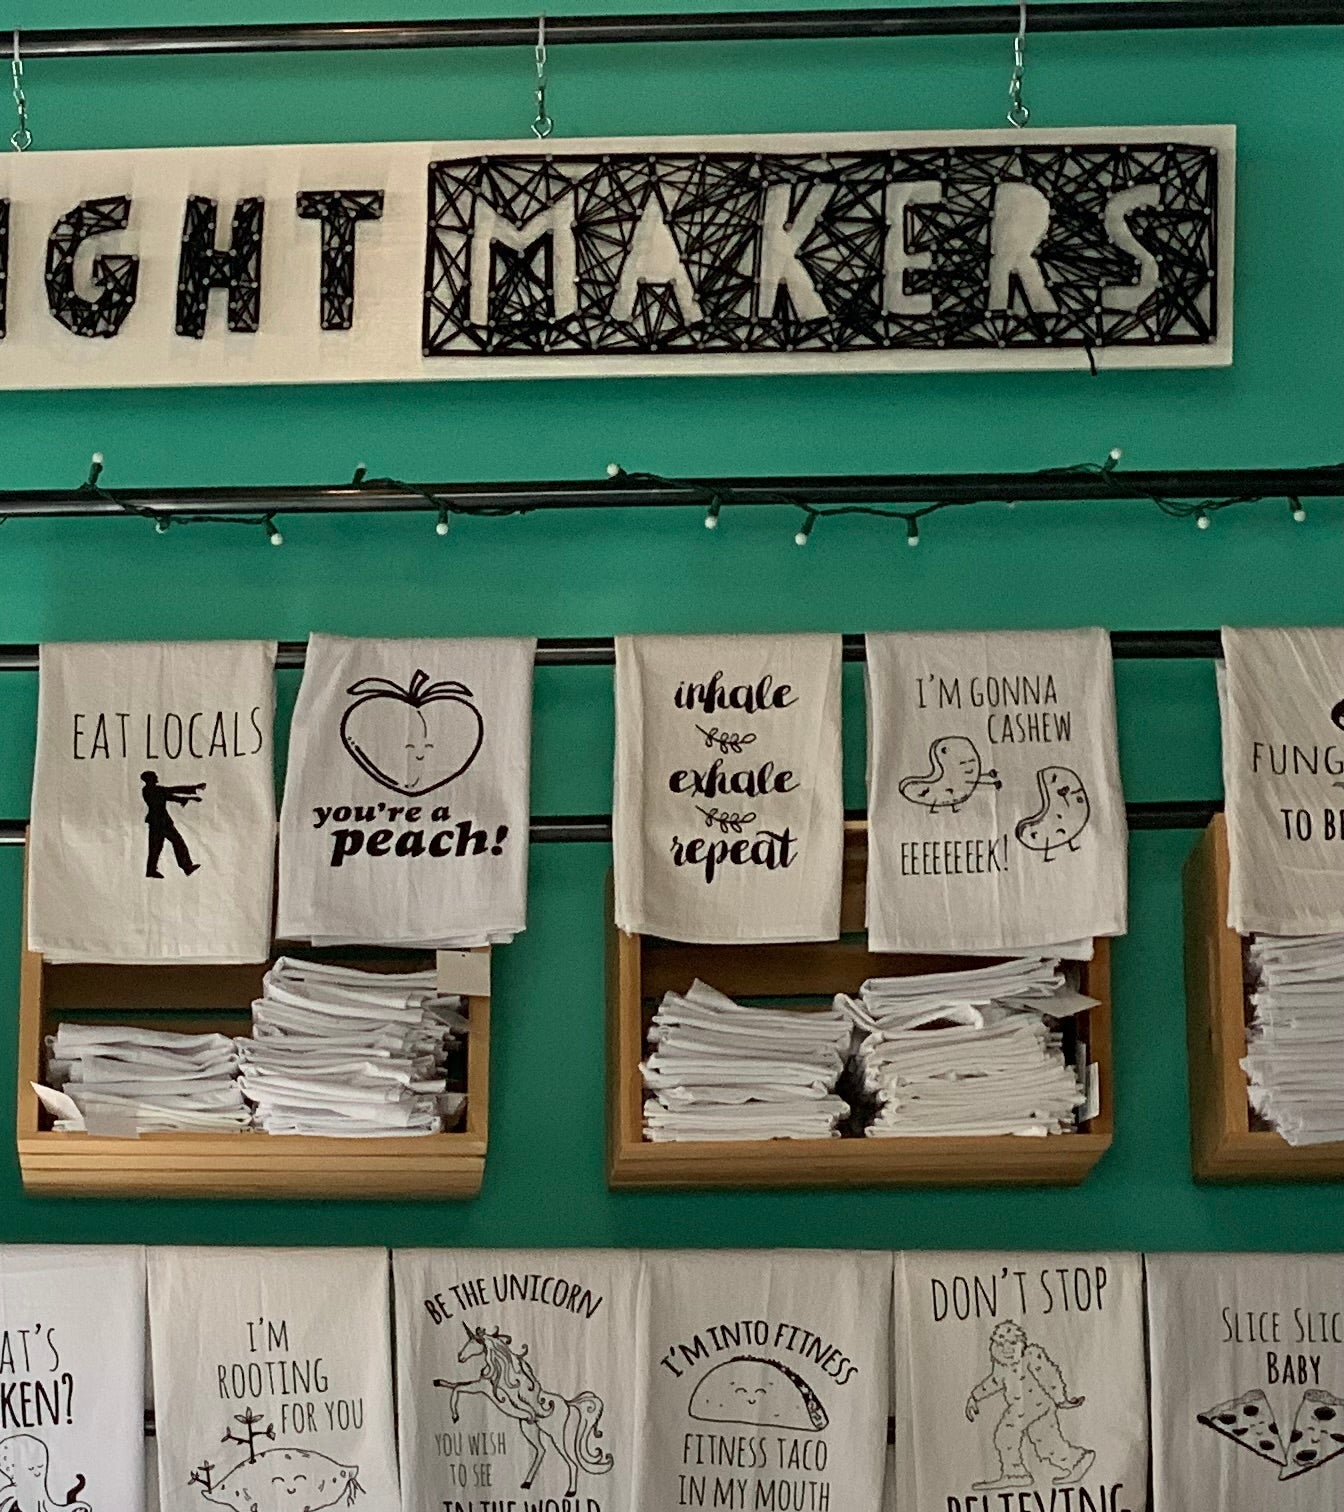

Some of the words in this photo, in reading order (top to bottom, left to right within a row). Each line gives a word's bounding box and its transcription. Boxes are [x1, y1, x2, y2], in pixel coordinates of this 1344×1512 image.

[467, 175, 1168, 333] MAKERS
[673, 671, 799, 713] inhale
[915, 674, 963, 710] I'M
[969, 674, 1058, 709] GONNA
[73, 712, 129, 760] EAT
[146, 706, 264, 759] LOCALS
[987, 712, 1073, 745] CASHEW
[669, 758, 801, 798] exhale
[313, 802, 421, 829] you're
[432, 804, 450, 822] a
[1279, 807, 1314, 842] TO
[330, 820, 509, 867] peach!
[670, 829, 799, 883] repeat
[424, 1297, 447, 1325] BE
[449, 1277, 487, 1312] THE
[493, 1273, 603, 1319] UNICORN
[931, 1267, 1028, 1322] DON'T
[1040, 1266, 1108, 1314] STOP
[248, 1317, 289, 1354] I'M
[1222, 1307, 1280, 1343] SLICE
[660, 1335, 710, 1378] I'M
[711, 1319, 770, 1352] INTO
[774, 1323, 860, 1385] FITNESS
[1267, 1351, 1321, 1385] BABY
[217, 1359, 329, 1399] ROOTING
[281, 1402, 318, 1434] FOR
[326, 1397, 364, 1431] YOU
[434, 1433, 463, 1456] YOU
[468, 1431, 507, 1456] WISH
[684, 1433, 769, 1469] FITNESS
[777, 1438, 828, 1471] TACO
[450, 1463, 469, 1488] TO
[474, 1463, 493, 1488] SEE
[679, 1474, 706, 1507] IN
[713, 1477, 748, 1510] MY
[756, 1479, 830, 1512] MOUTH
